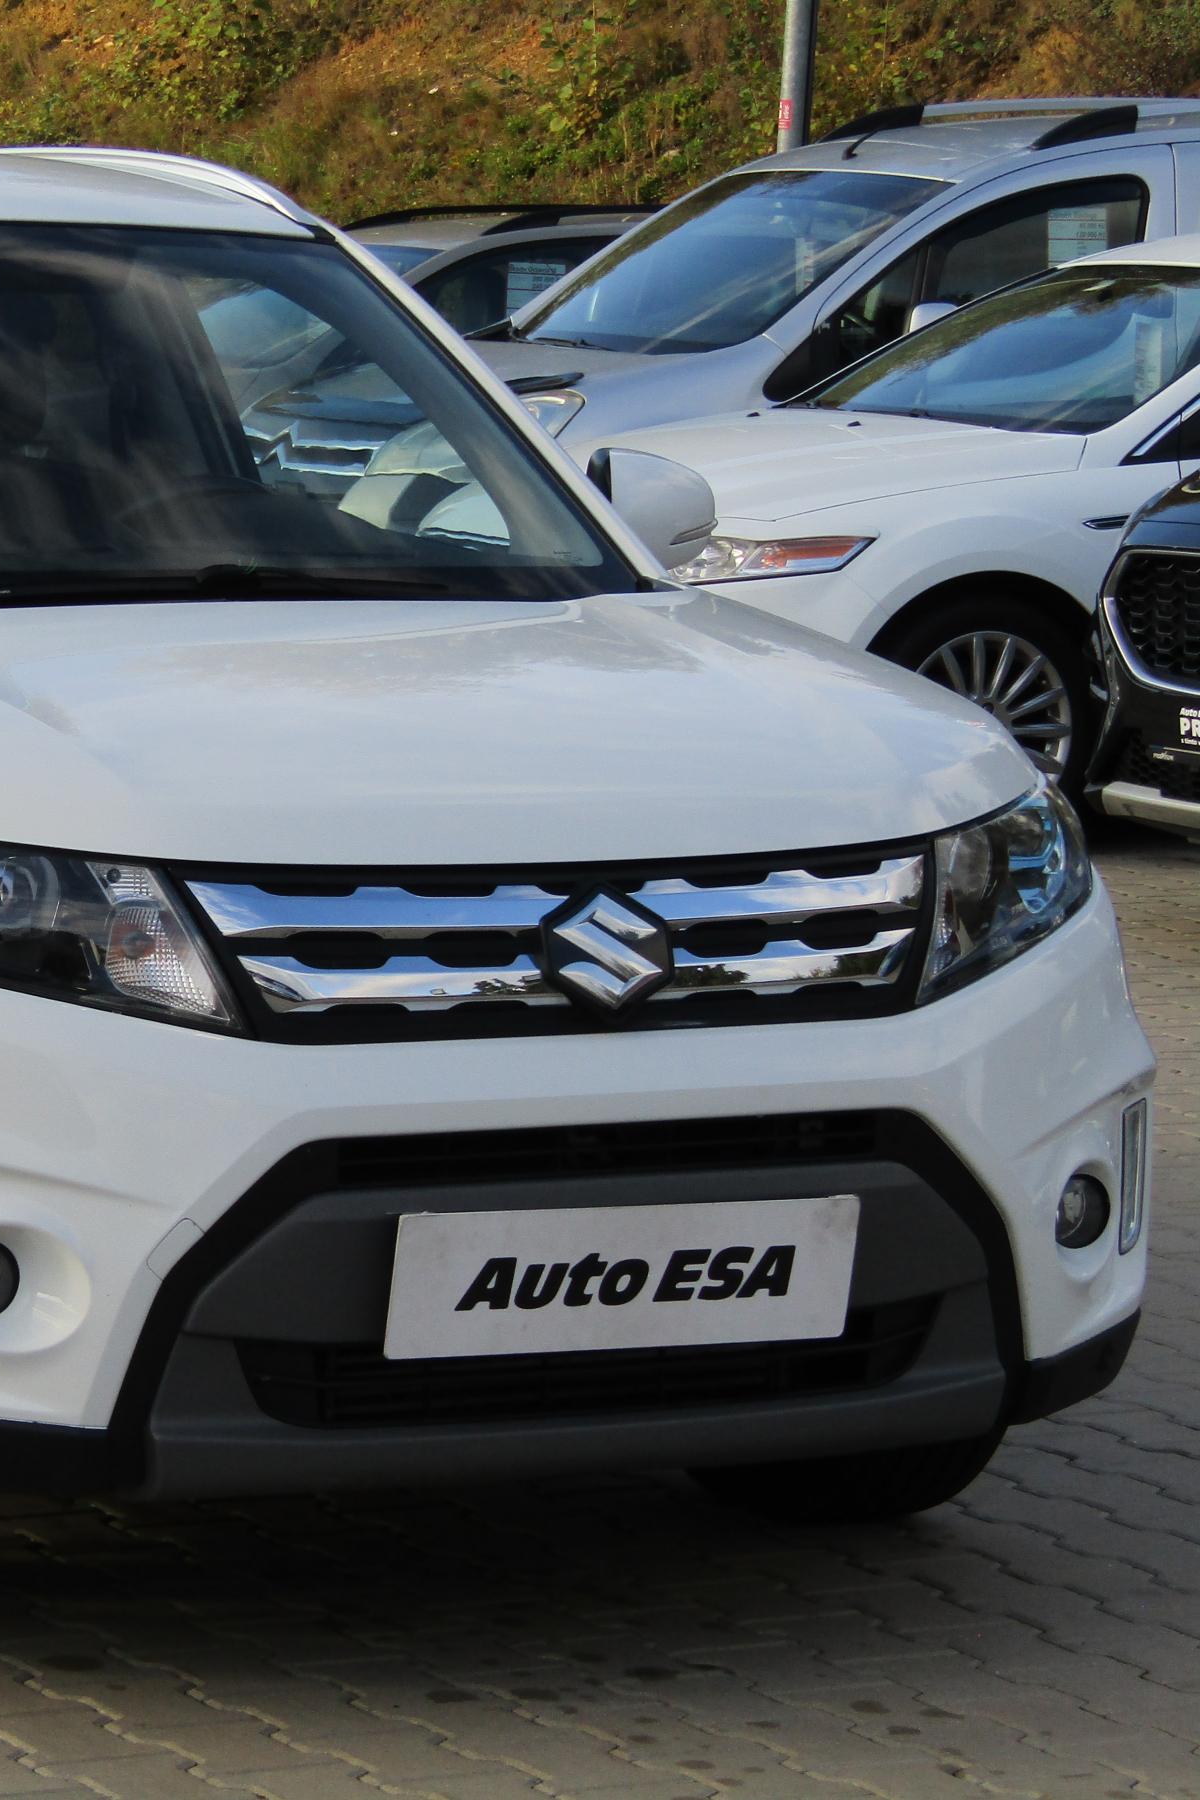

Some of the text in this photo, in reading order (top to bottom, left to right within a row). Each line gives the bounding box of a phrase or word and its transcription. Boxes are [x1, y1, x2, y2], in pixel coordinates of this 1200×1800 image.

[1180, 707, 1198, 718] Auto
[455, 1245, 796, 1311] Auto ESA
